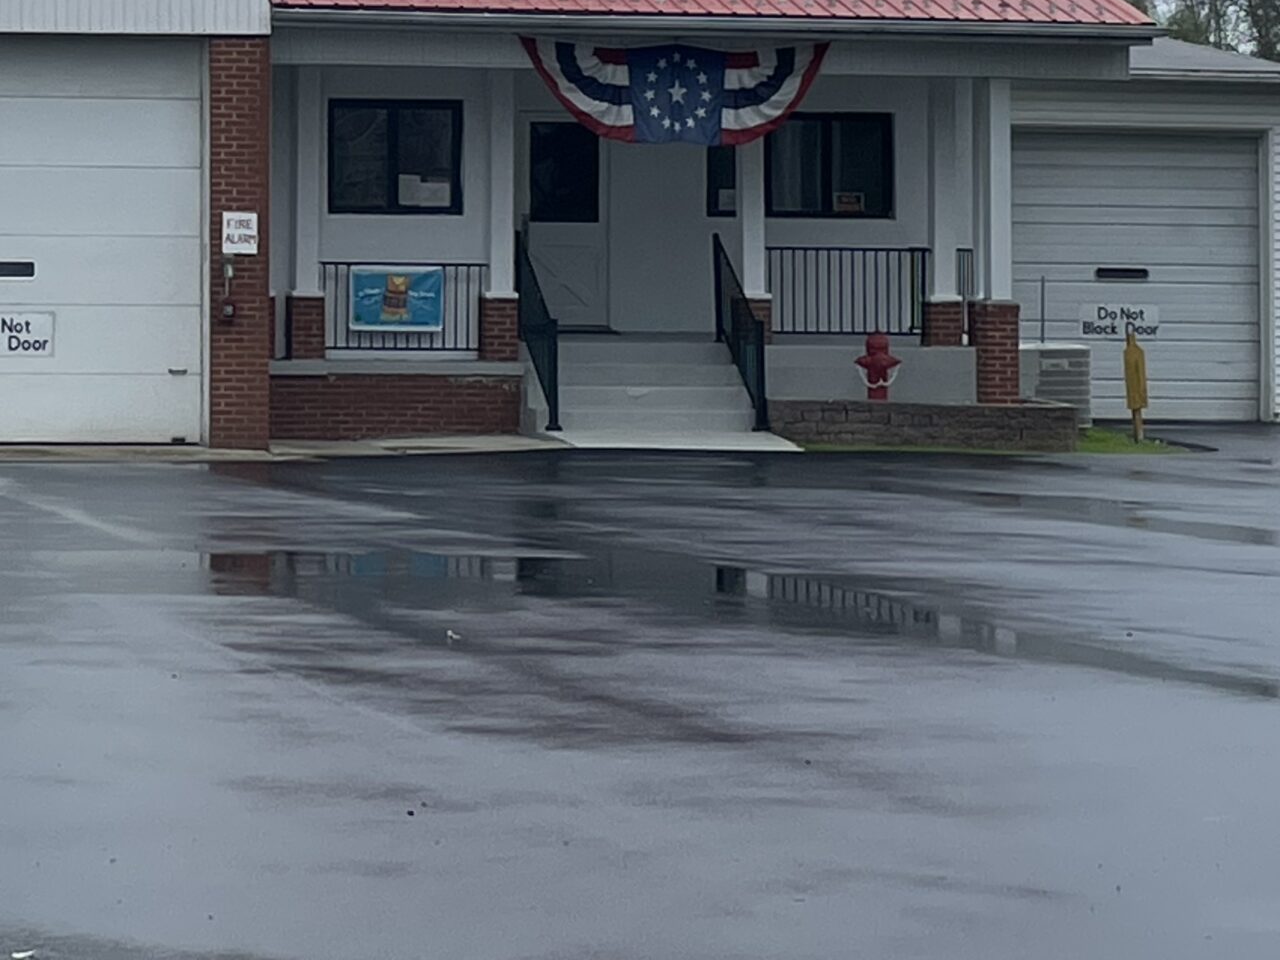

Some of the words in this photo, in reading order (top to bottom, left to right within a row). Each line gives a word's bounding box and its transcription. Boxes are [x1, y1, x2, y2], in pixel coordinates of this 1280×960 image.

[226, 218, 253, 230] FIRE
[224, 233, 257, 245] ALARM
[1097, 306, 1118, 320] Do
[1120, 307, 1145, 321] Not
[1, 317, 31, 334] Not
[1082, 321, 1118, 335] Block
[1125, 321, 1159, 335] Door
[8, 335, 49, 351] Door
